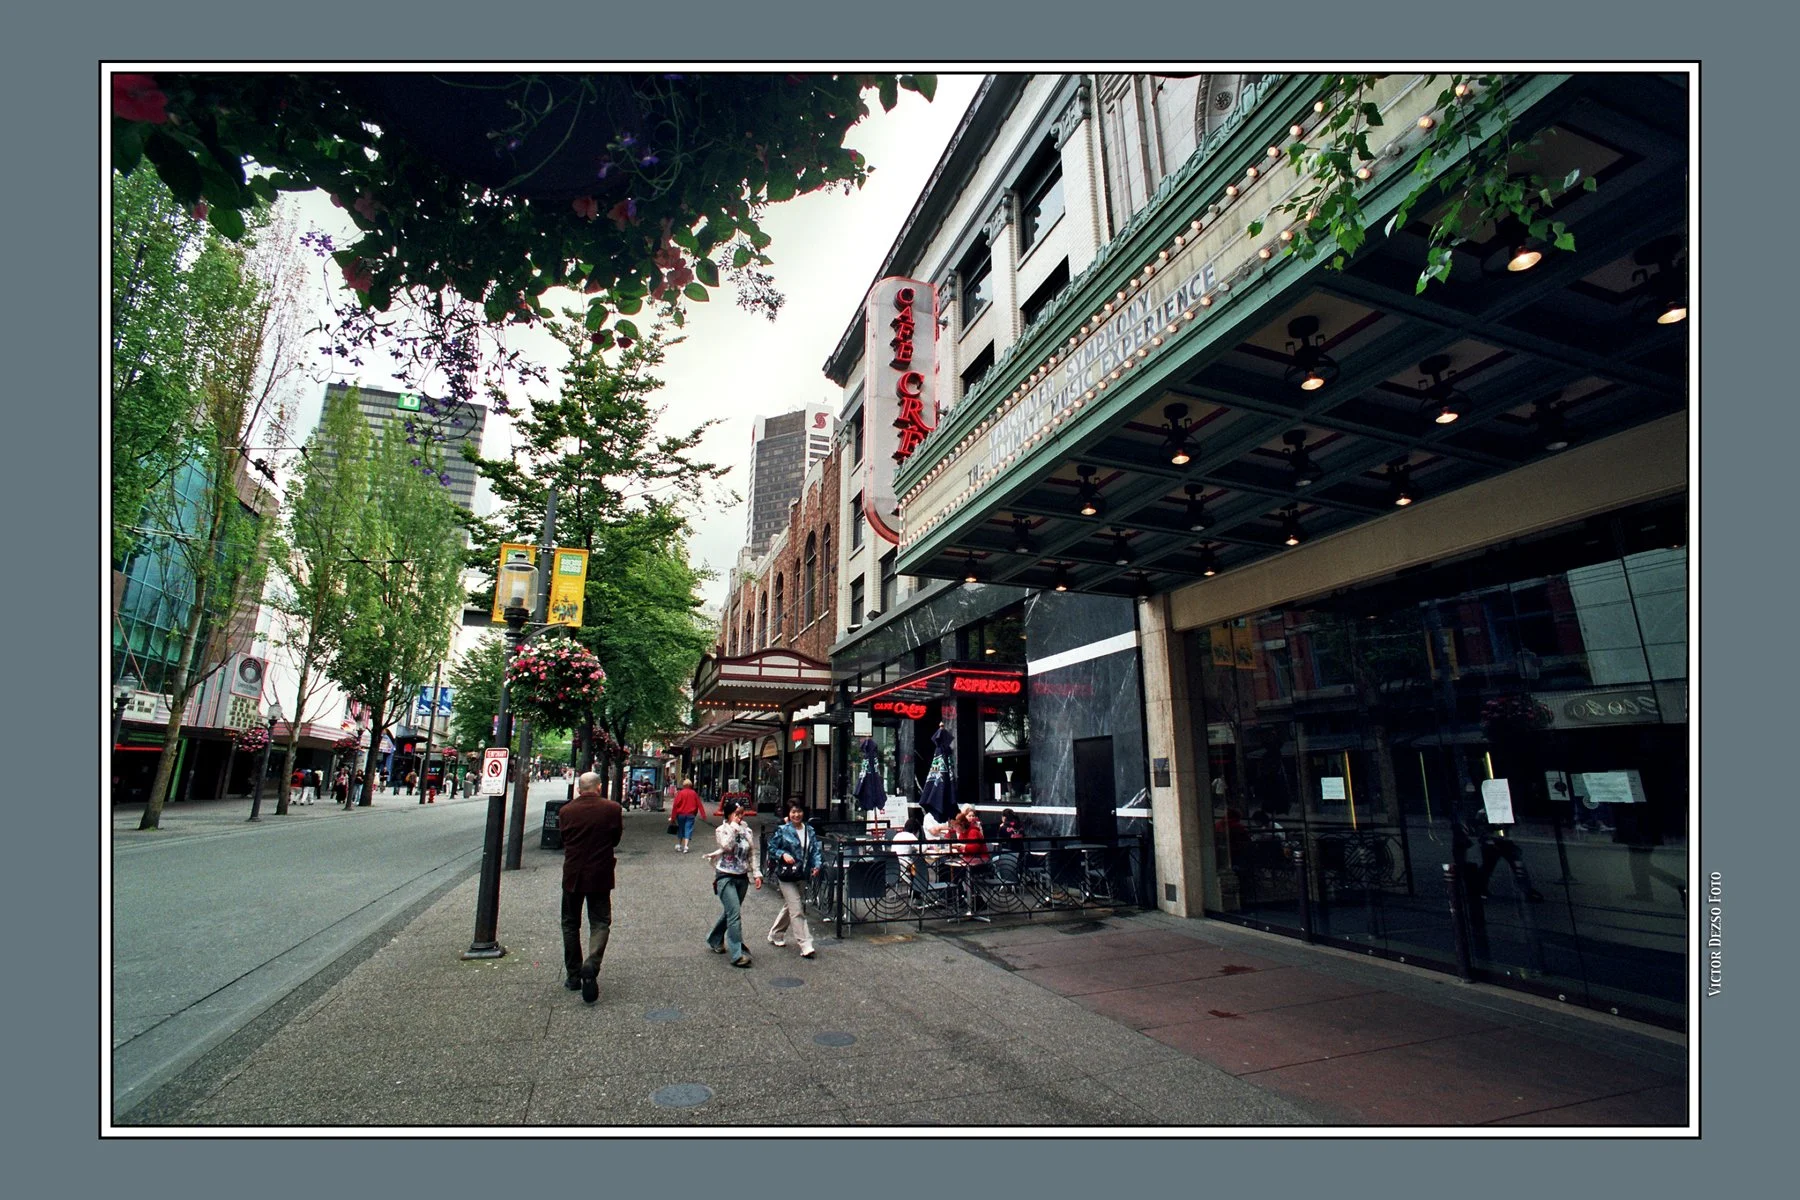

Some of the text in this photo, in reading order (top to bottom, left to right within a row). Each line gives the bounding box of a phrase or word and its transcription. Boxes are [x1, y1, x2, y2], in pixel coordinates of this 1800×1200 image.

[968, 263, 1216, 486] THE ULTIMATE MUSIC EXPERIENCE
[990, 290, 1152, 448] VANCOUVER SYMPHONY
[953, 677, 1021, 694] ESPRESSO
